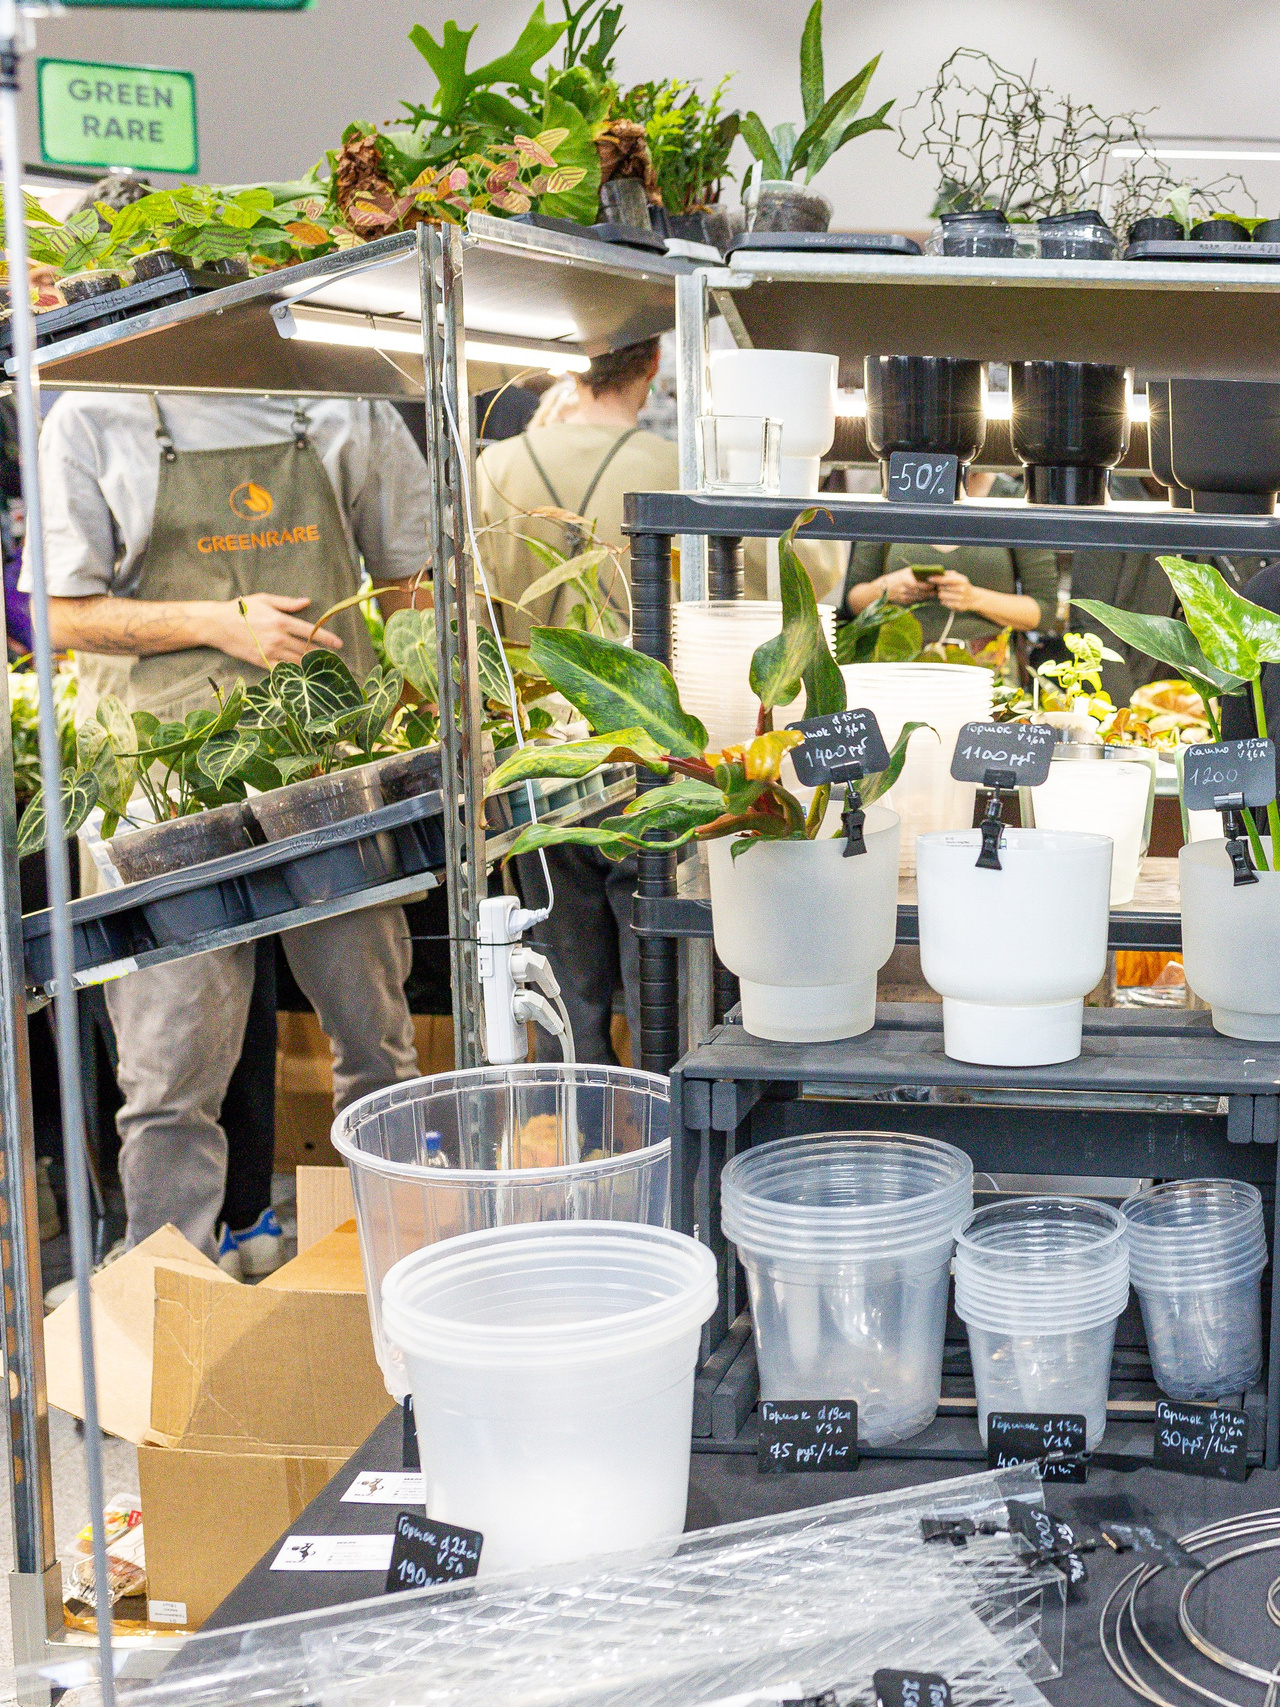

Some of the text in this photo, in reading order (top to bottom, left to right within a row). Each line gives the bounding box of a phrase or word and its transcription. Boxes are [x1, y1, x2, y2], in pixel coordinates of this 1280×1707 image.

[68, 78, 173, 108] GREEN
[82, 115, 164, 144] RARE
[197, 523, 320, 554] GREENRARE
[1189, 766, 1238, 786] 1200
